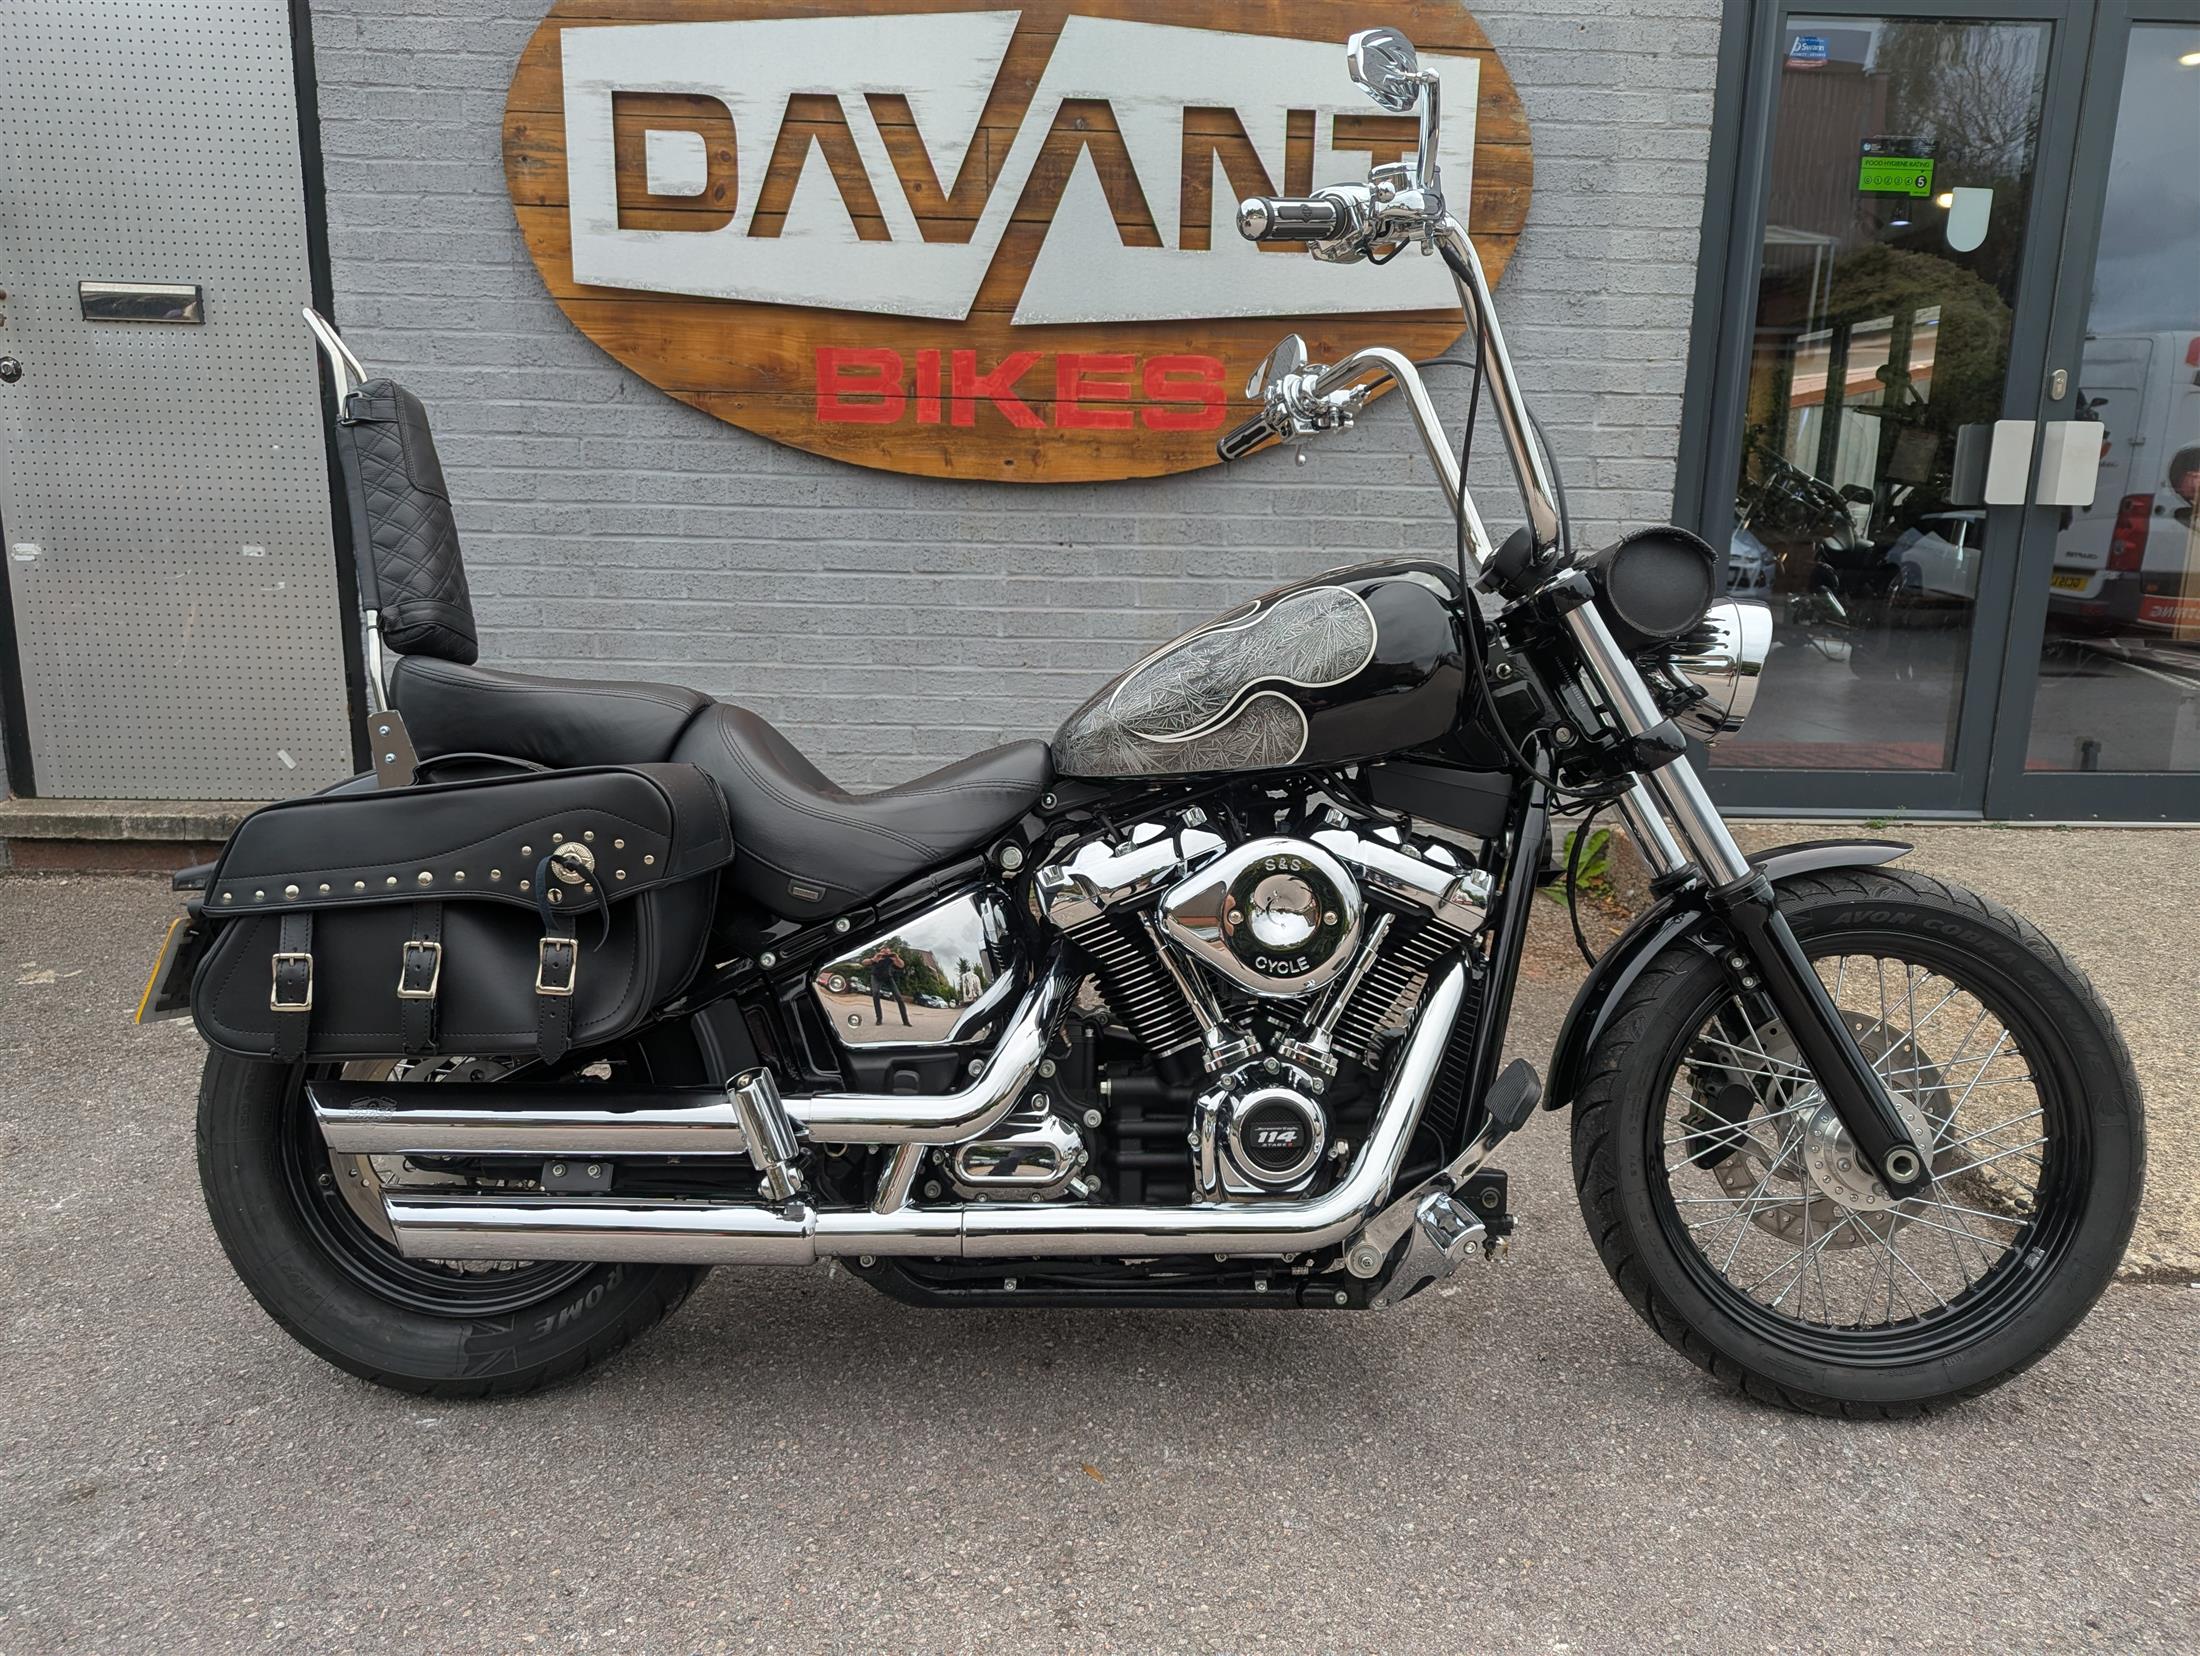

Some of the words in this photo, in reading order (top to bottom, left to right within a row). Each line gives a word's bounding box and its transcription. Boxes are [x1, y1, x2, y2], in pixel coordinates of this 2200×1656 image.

[611, 90, 1421, 254] DAVANT
[1917, 177, 1925, 187] 5
[816, 347, 1228, 431] BIKES
[1265, 858, 1301, 871] S&S
[1255, 956, 1310, 974] CYCLE
[1835, 910, 1916, 925] AVON
[1923, 918, 2019, 964] COBRA
[2023, 968, 2110, 1076] CHROME
[1258, 1131, 1297, 1143] 114
[528, 1263, 624, 1342] ROME
